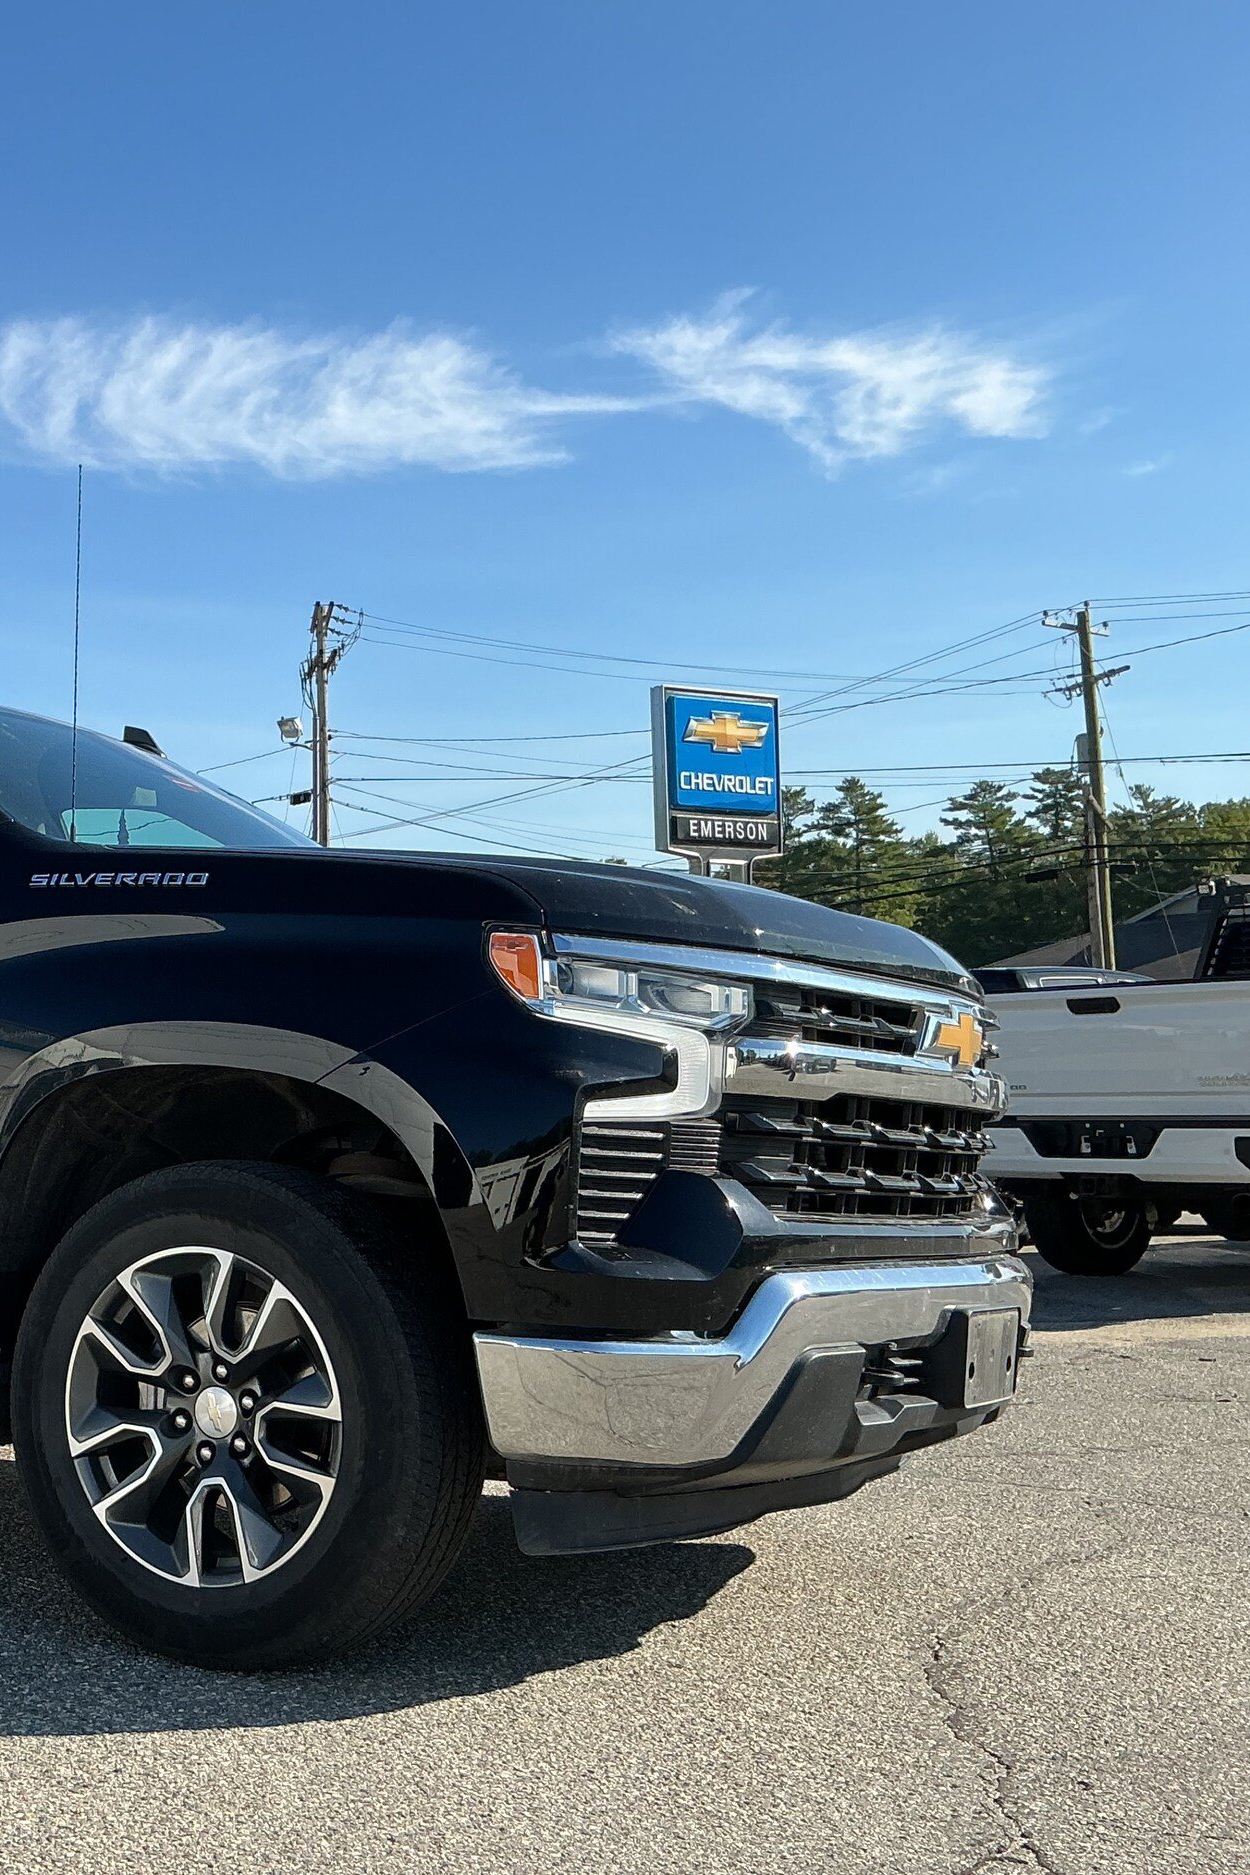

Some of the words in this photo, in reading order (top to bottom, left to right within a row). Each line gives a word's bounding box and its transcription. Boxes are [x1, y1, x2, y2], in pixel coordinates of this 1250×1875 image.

[680, 771, 774, 795] CHEVROLET
[689, 819, 768, 841] EMERSON
[29, 872, 209, 886] SILVERADO
